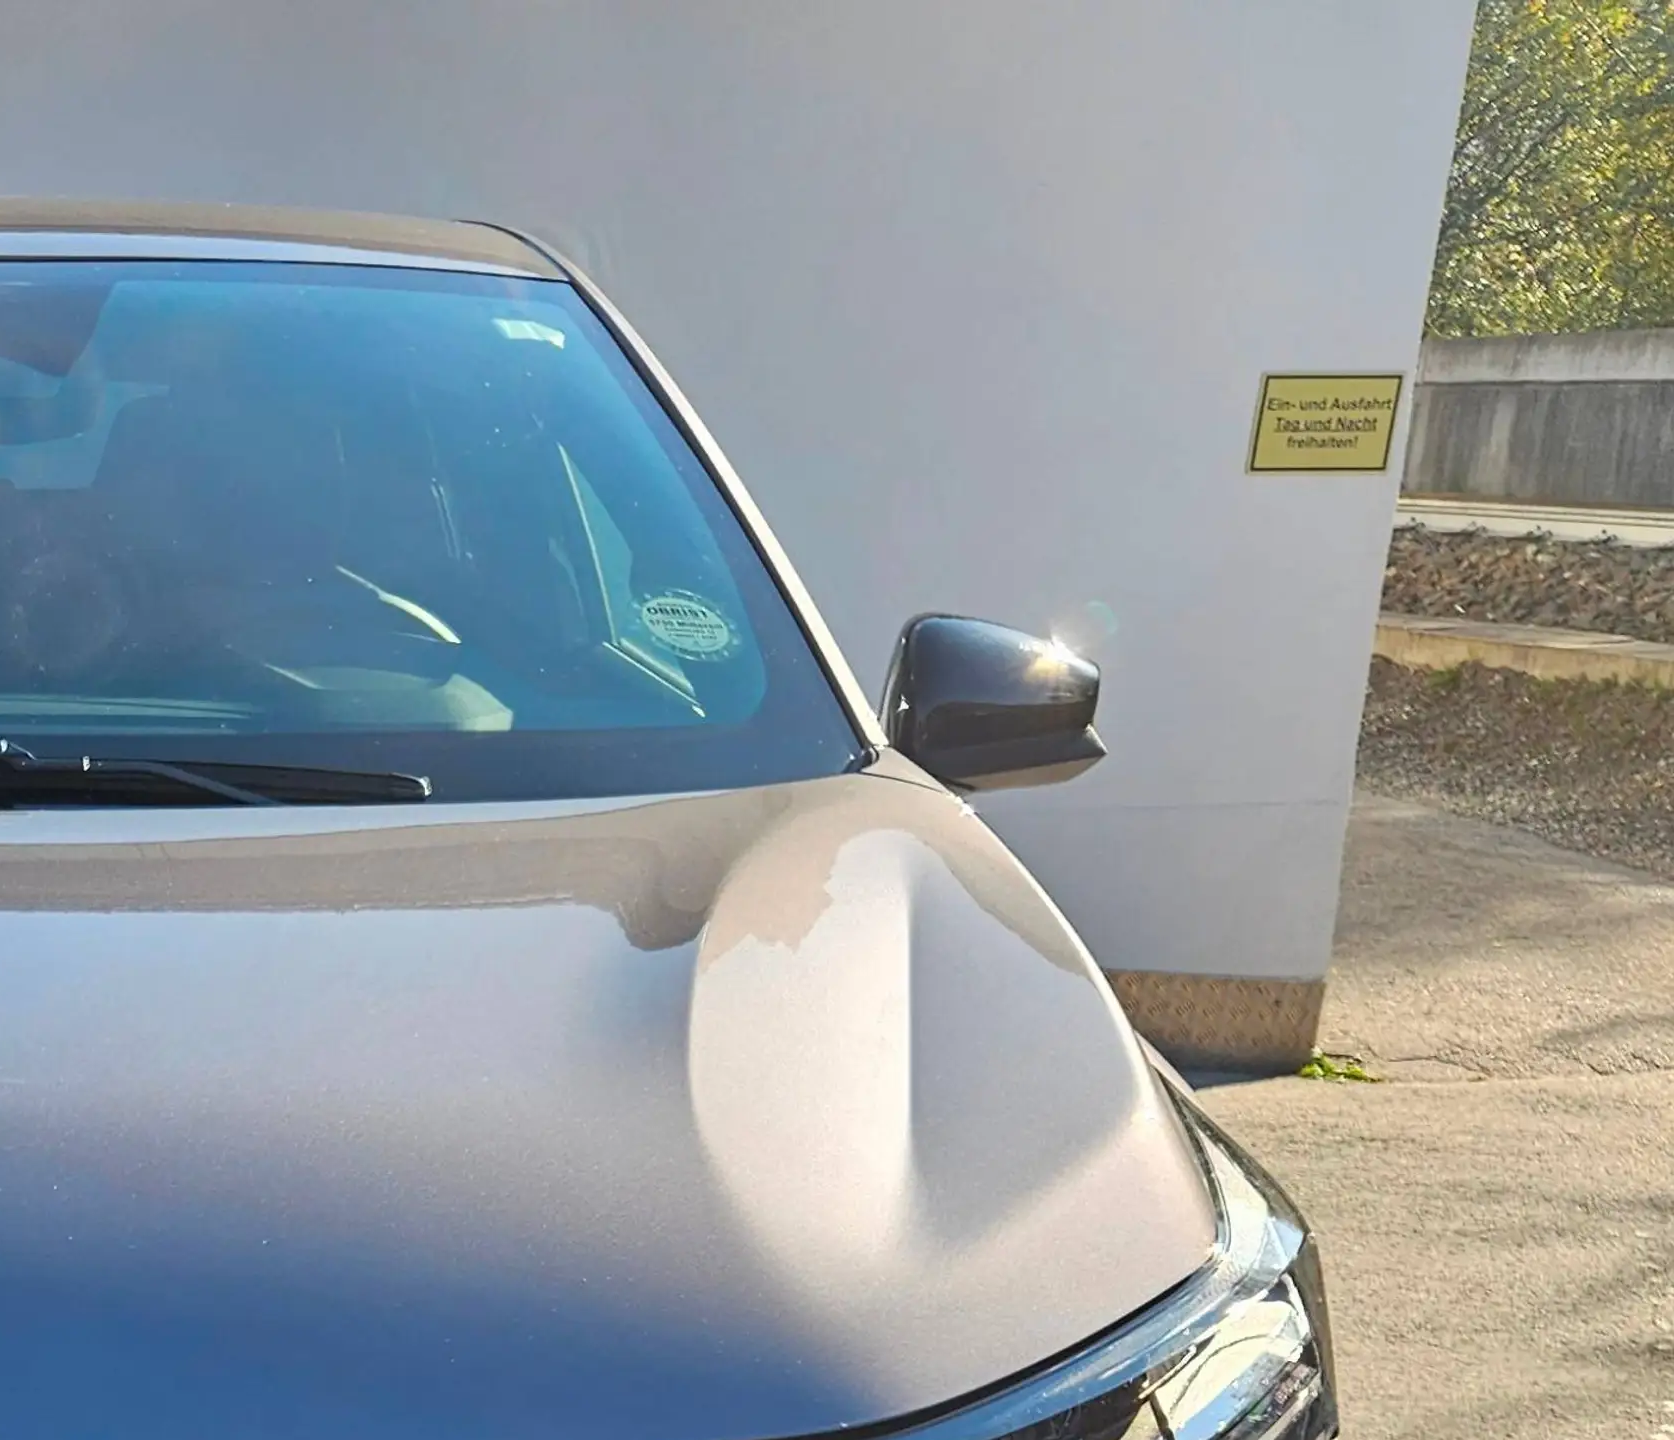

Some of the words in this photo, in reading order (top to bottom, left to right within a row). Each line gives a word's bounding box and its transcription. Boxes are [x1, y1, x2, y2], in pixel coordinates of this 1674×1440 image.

[1267, 398, 1296, 411] Ein-
[1299, 398, 1327, 410] und
[1330, 397, 1392, 411] Ausfahrt
[1275, 417, 1301, 431] Tag
[1305, 418, 1331, 431] und
[1335, 417, 1377, 431] Nacht
[1287, 435, 1358, 448] freihalten!
